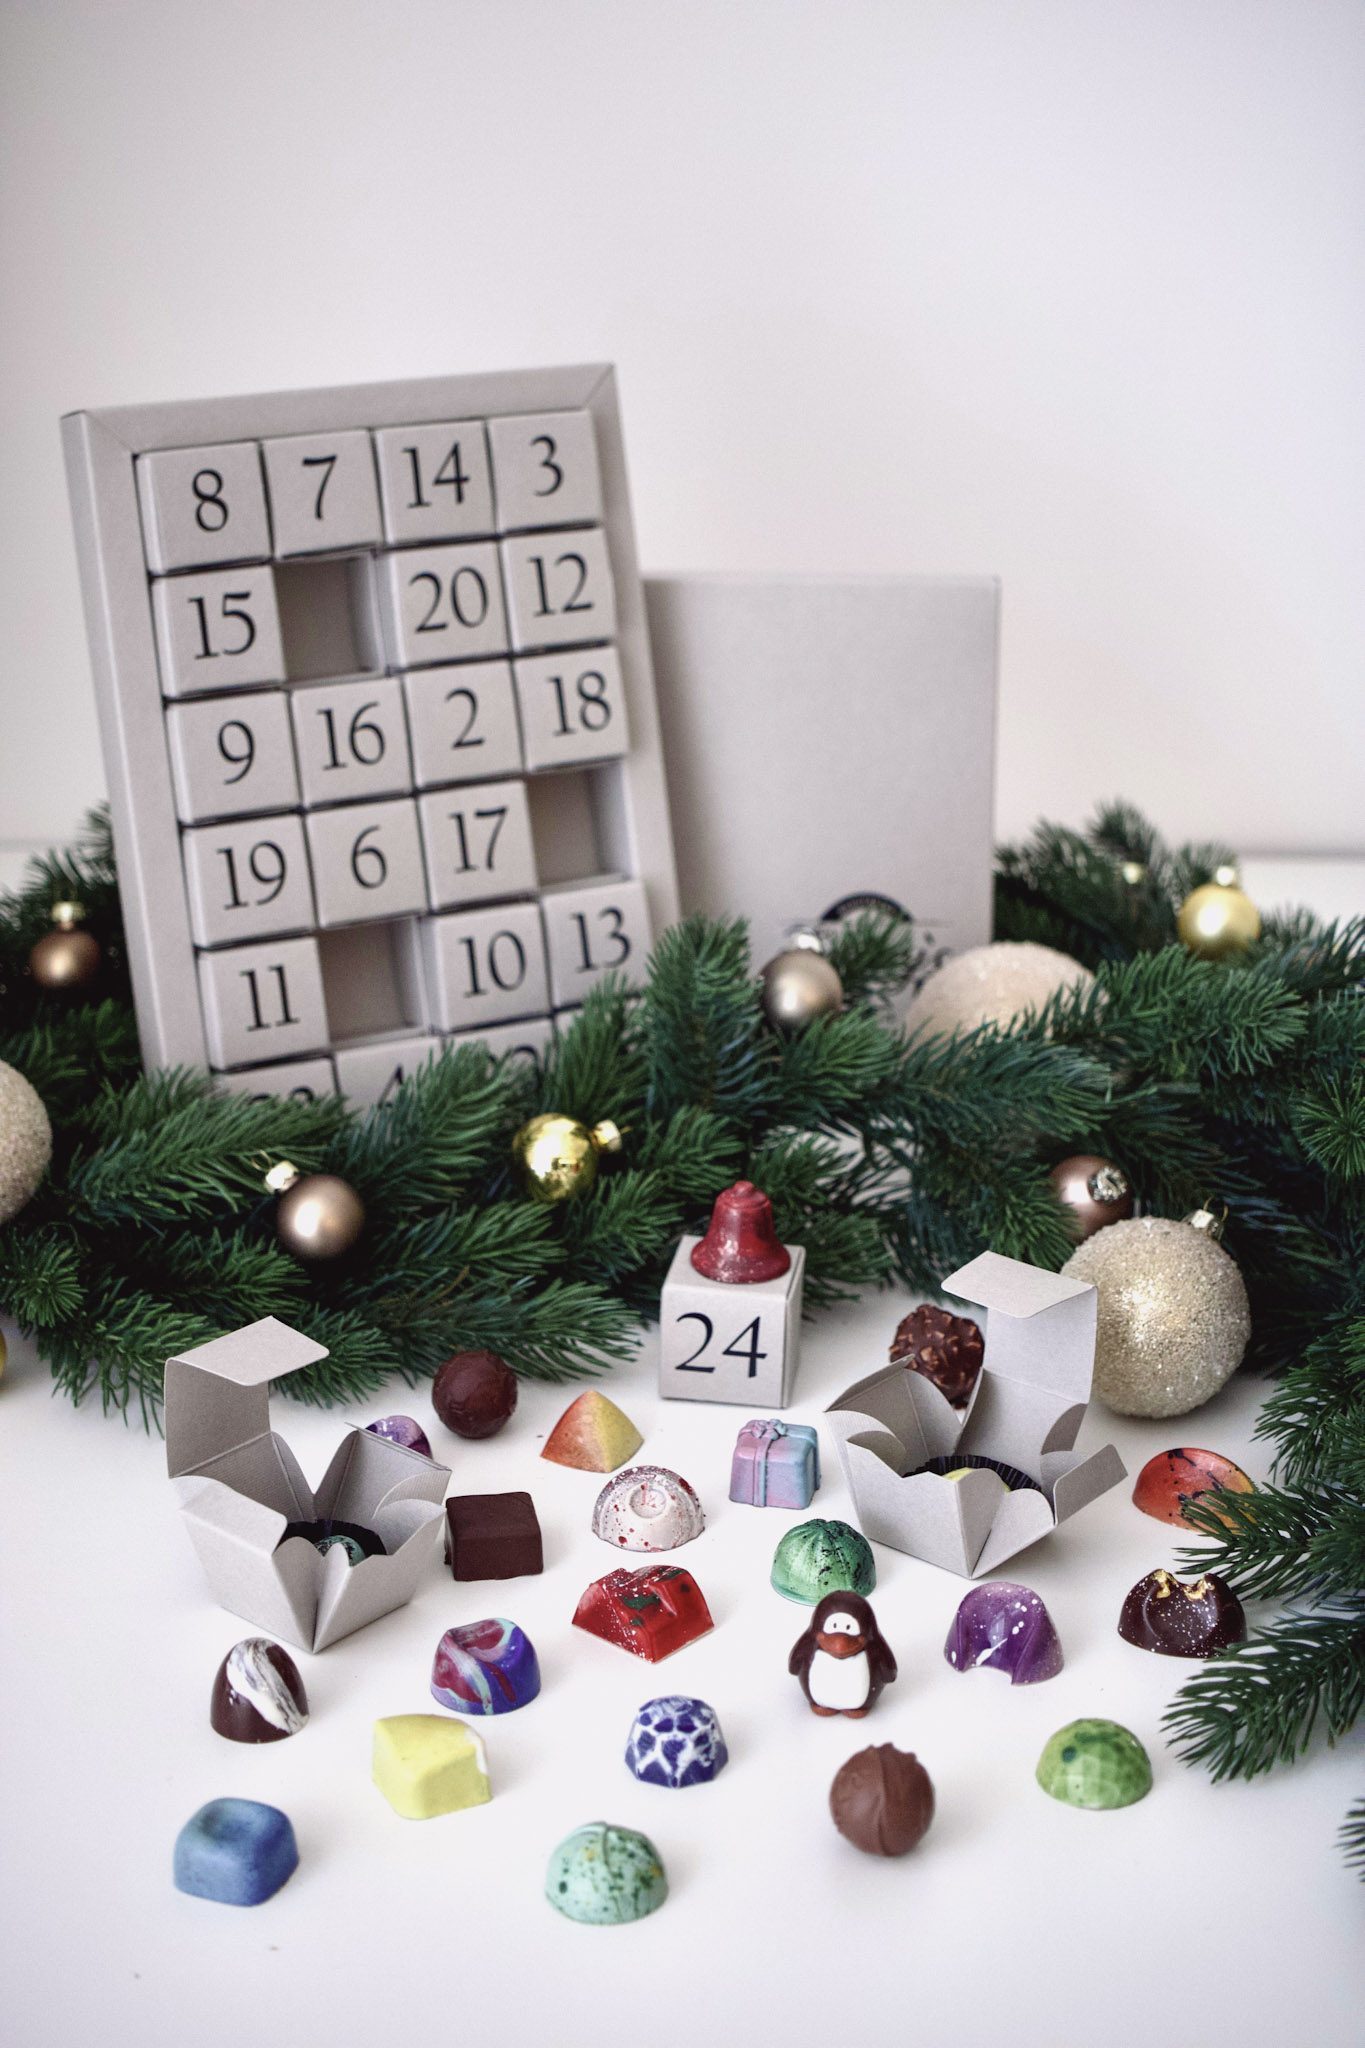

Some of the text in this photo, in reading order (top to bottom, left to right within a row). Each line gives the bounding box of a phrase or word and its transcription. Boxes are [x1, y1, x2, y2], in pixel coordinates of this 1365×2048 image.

[301, 454, 337, 520] 7
[403, 442, 470, 508] 14
[531, 434, 563, 496] 3
[191, 468, 228, 532] 8
[410, 566, 488, 633] 20
[529, 552, 593, 616] 12
[188, 591, 256, 659] 15
[318, 702, 385, 770] 16
[446, 687, 484, 749] 2
[549, 670, 610, 736] 18
[217, 720, 255, 784] 9
[350, 826, 387, 889] 6
[450, 806, 507, 872] 17
[217, 840, 286, 909] 19
[460, 931, 526, 997] 10
[573, 907, 631, 972] 13
[241, 964, 298, 1031] 11
[674, 1312, 767, 1378] 24
